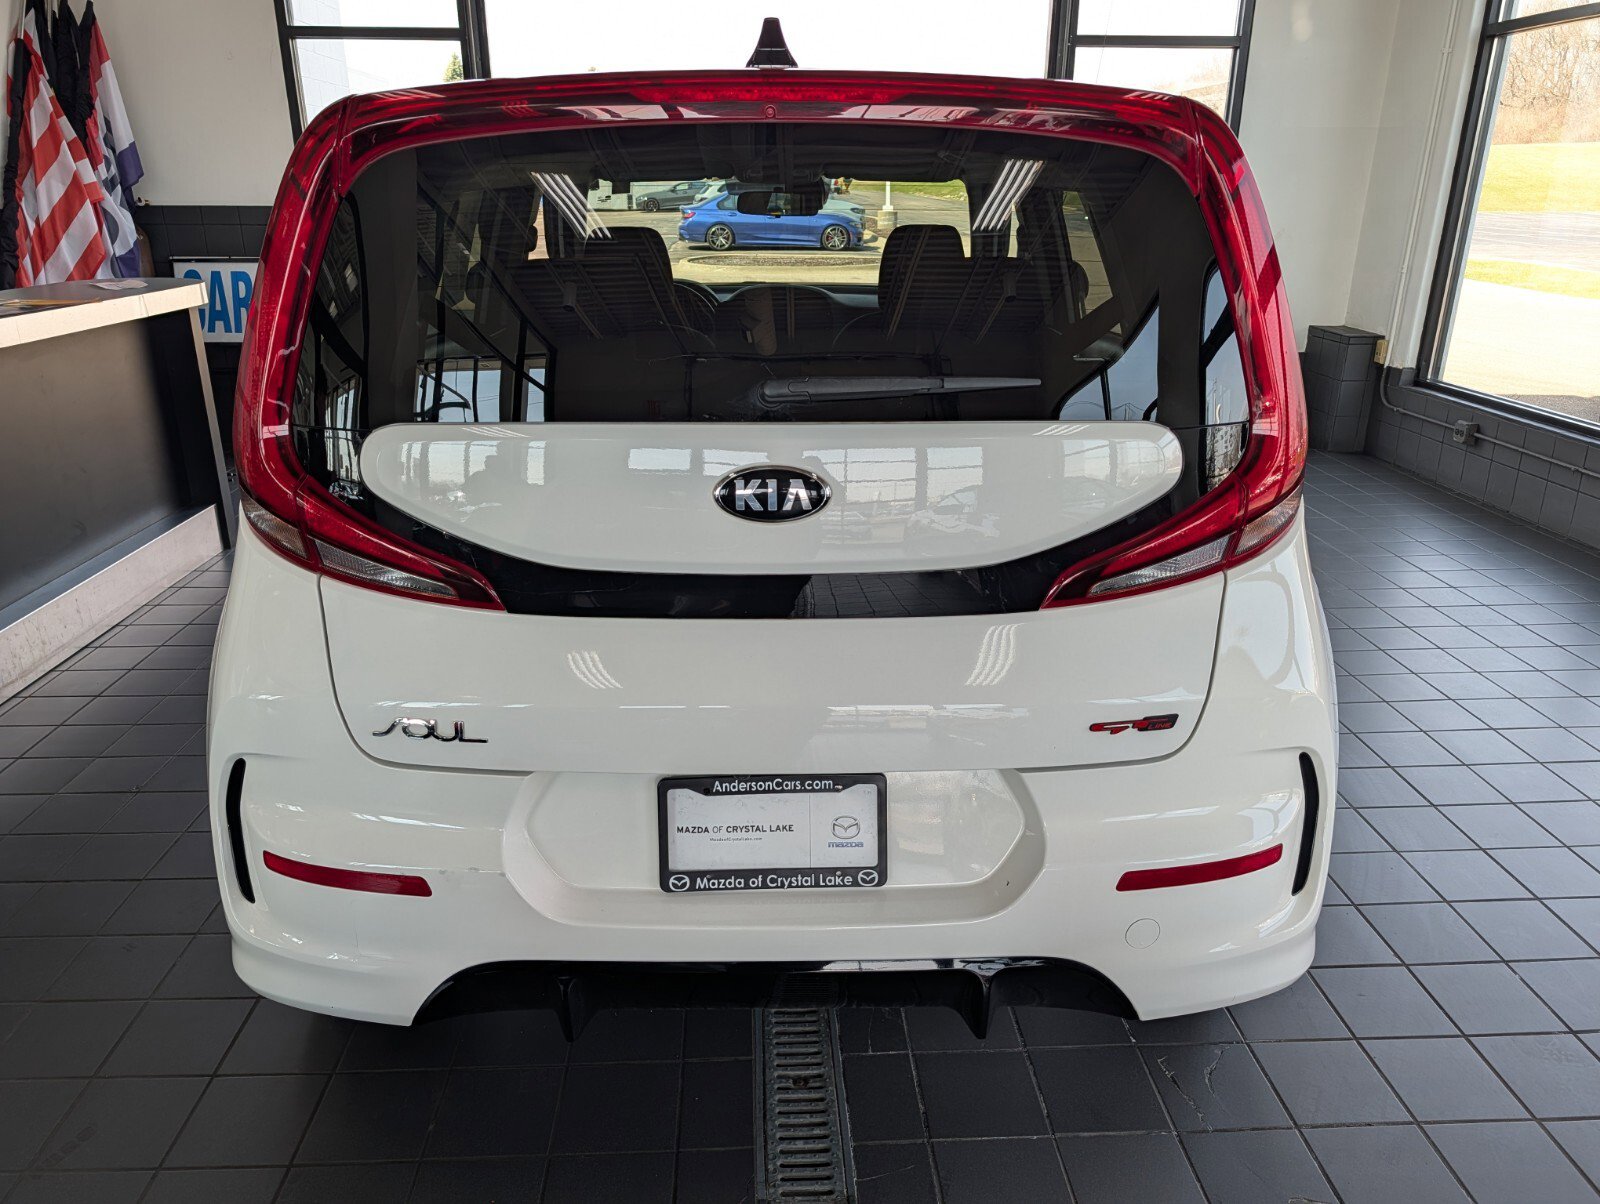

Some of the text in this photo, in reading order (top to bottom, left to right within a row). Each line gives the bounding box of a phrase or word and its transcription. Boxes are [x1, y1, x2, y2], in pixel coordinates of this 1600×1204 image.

[183, 269, 253, 333] AR
[734, 479, 812, 511] KIA
[372, 717, 488, 743] SOUL
[713, 779, 833, 792] AndersonCars.com
[676, 826, 710, 834] MAZDA
[726, 825, 767, 833] CRYSTAL
[769, 824, 794, 832] LAKE
[696, 873, 852, 889] Mazda of Crystal Lake
